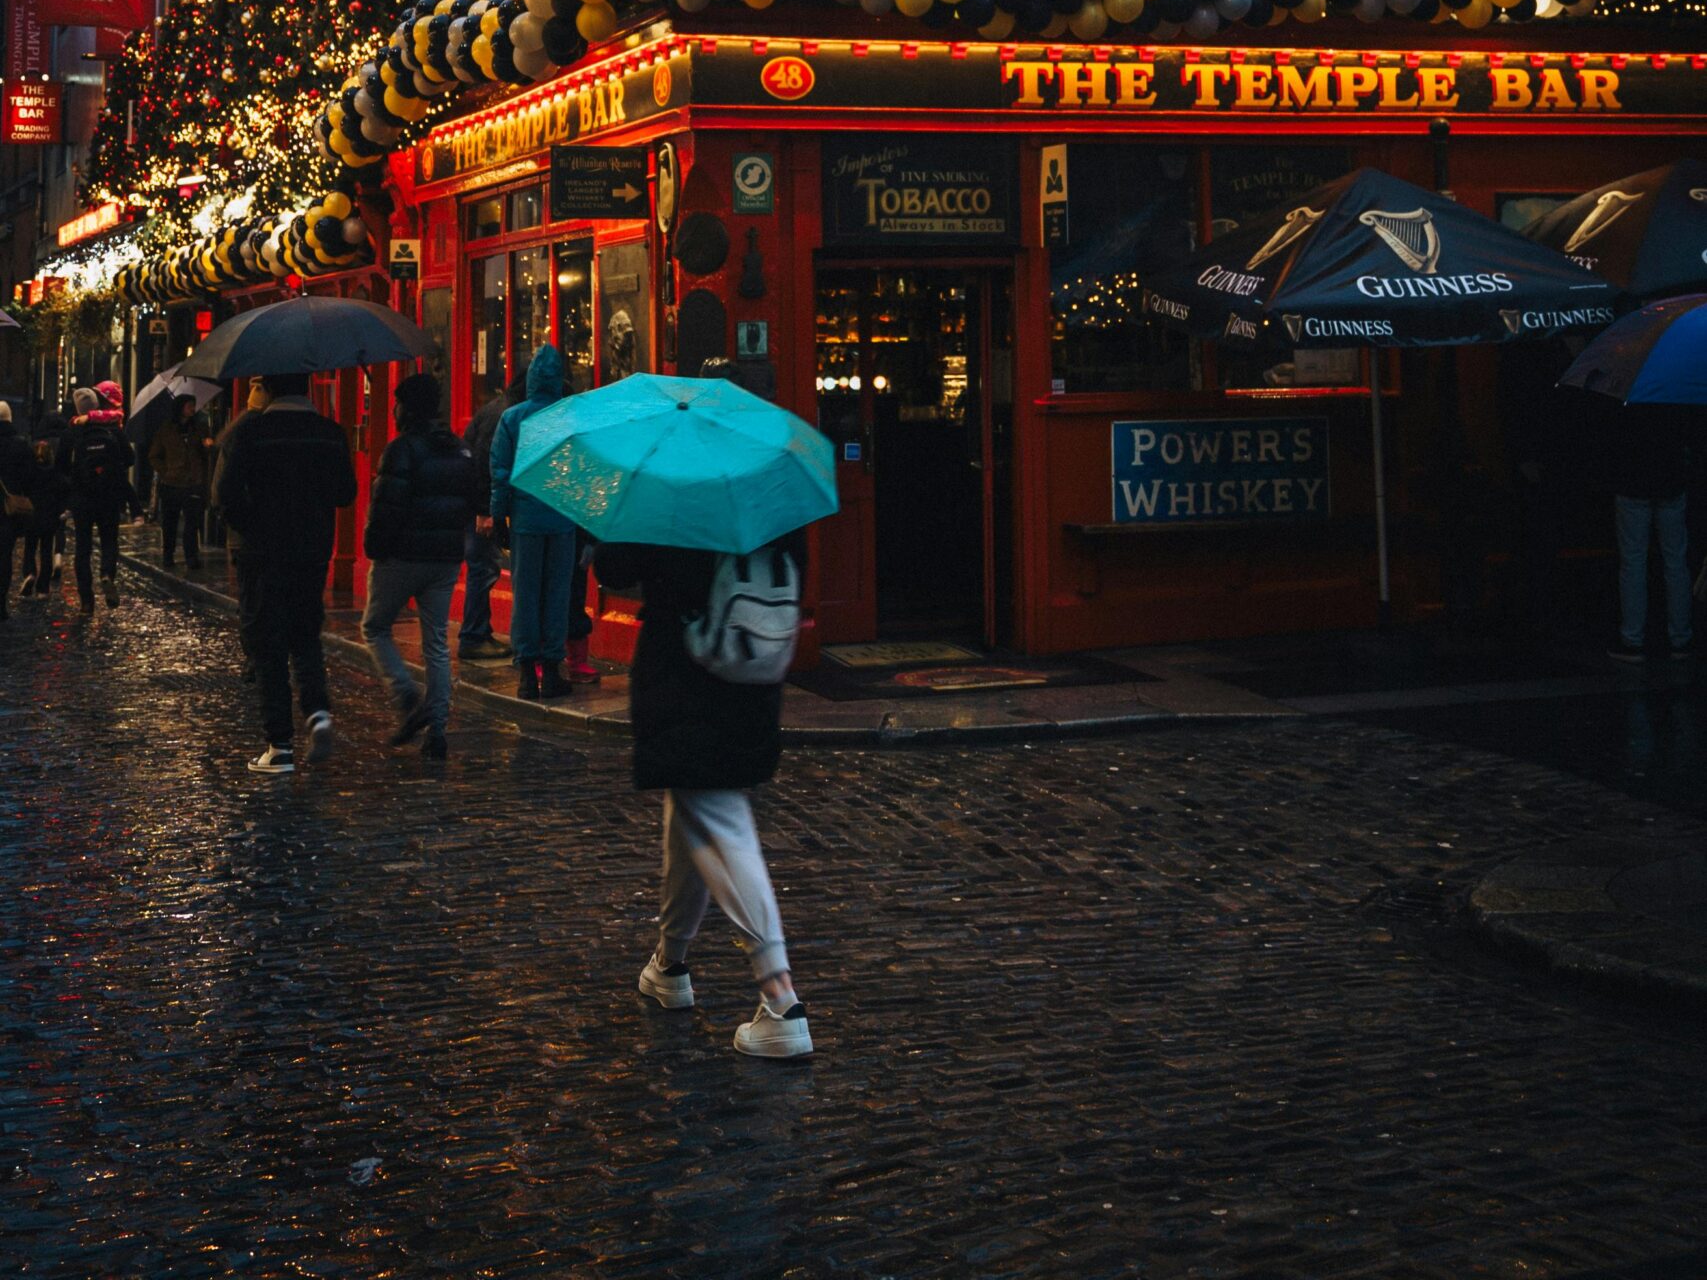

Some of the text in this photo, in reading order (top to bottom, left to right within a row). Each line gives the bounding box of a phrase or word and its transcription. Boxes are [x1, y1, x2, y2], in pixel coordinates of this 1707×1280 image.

[771, 62, 804, 89] 48
[1004, 61, 1622, 109] THE TEMPLE BAR
[22, 85, 45, 95] THE
[9, 96, 56, 107] TEMPLE
[18, 108, 44, 119] BAR
[14, 124, 50, 132] TRADING
[452, 78, 626, 171] THE TEMPLE BAR
[11, 132, 51, 140] COMPANY
[882, 218, 935, 232] Always
[942, 218, 956, 231] in
[1356, 272, 1514, 299] GUINNESS
[1305, 317, 1394, 337] GUINNESS
[1522, 306, 1615, 329] GUINNESS
[1118, 478, 1324, 517] WHISKEY
